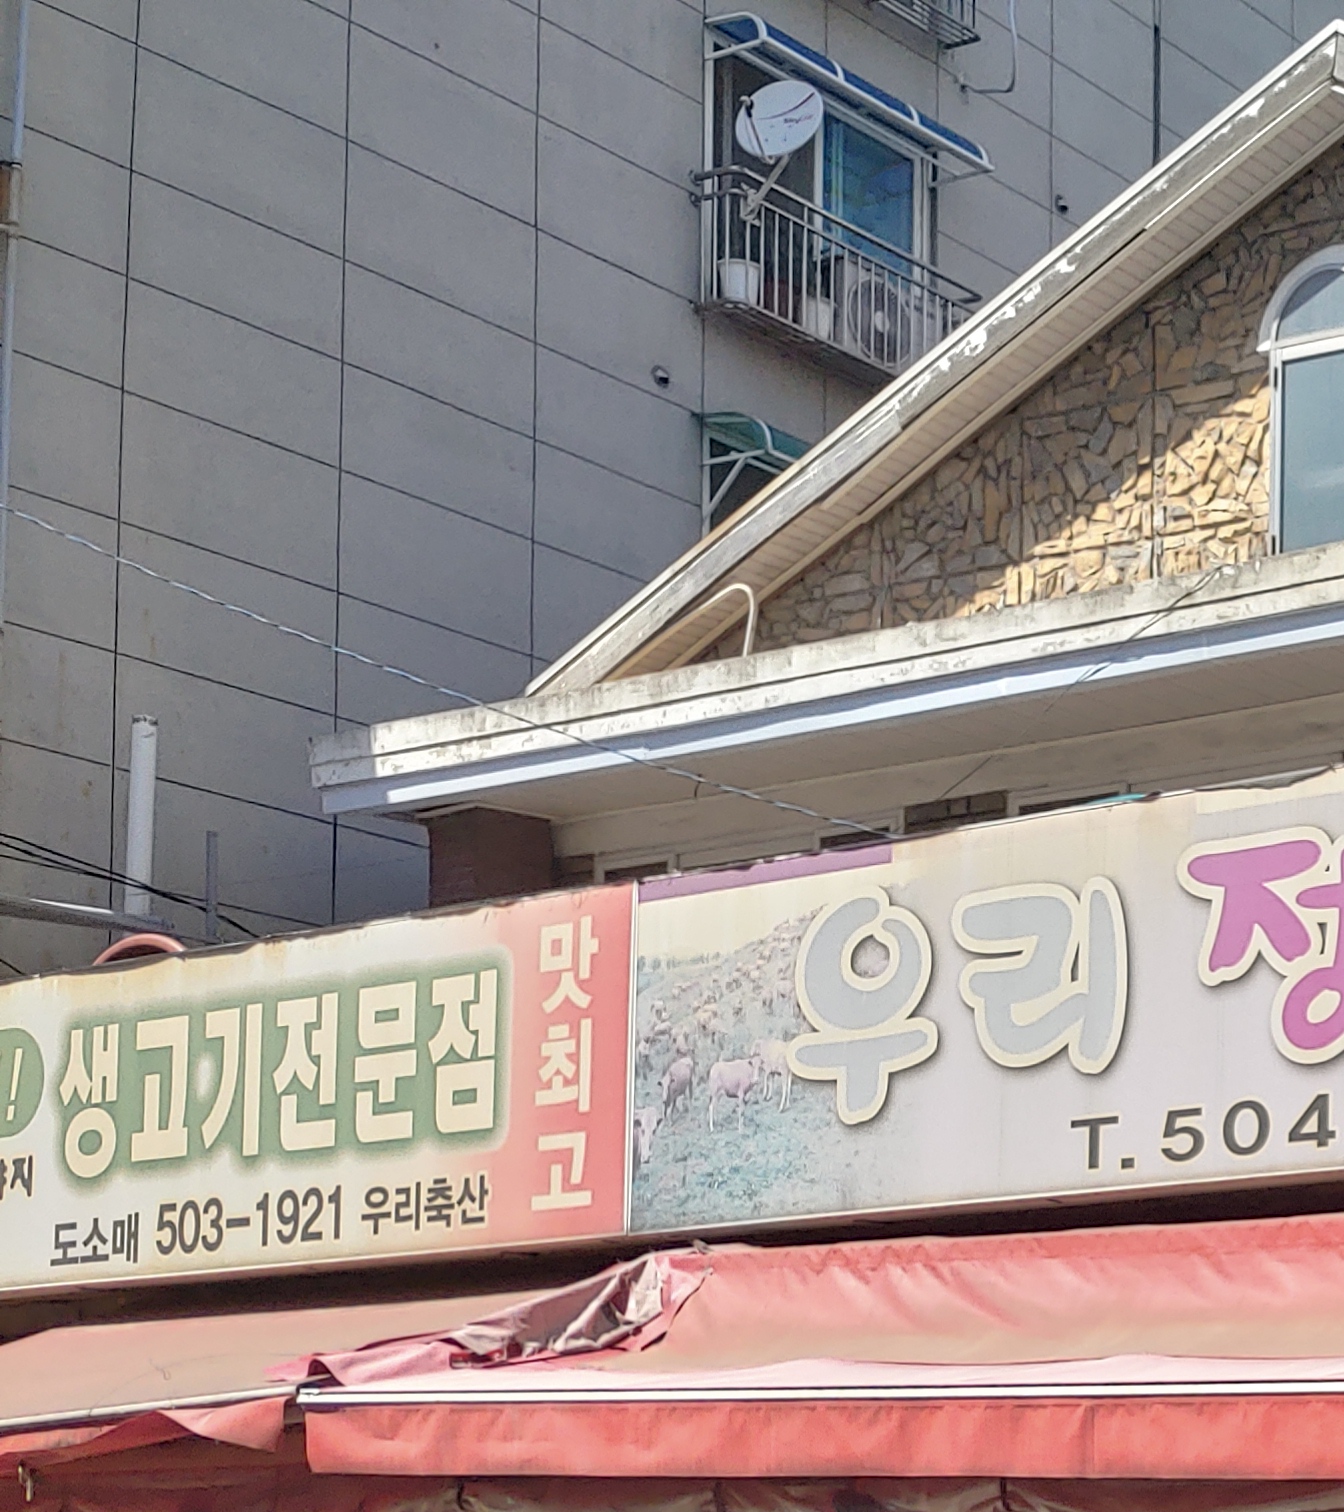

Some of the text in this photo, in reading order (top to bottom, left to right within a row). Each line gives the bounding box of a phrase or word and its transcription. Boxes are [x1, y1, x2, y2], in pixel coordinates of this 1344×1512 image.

[58, 968, 499, 1179] 생고기전문점
[530, 914, 600, 1213] 맛최고
[787, 876, 1130, 1126] 우리
[50, 1173, 490, 1268] 도소매 503-1921 우리축산
